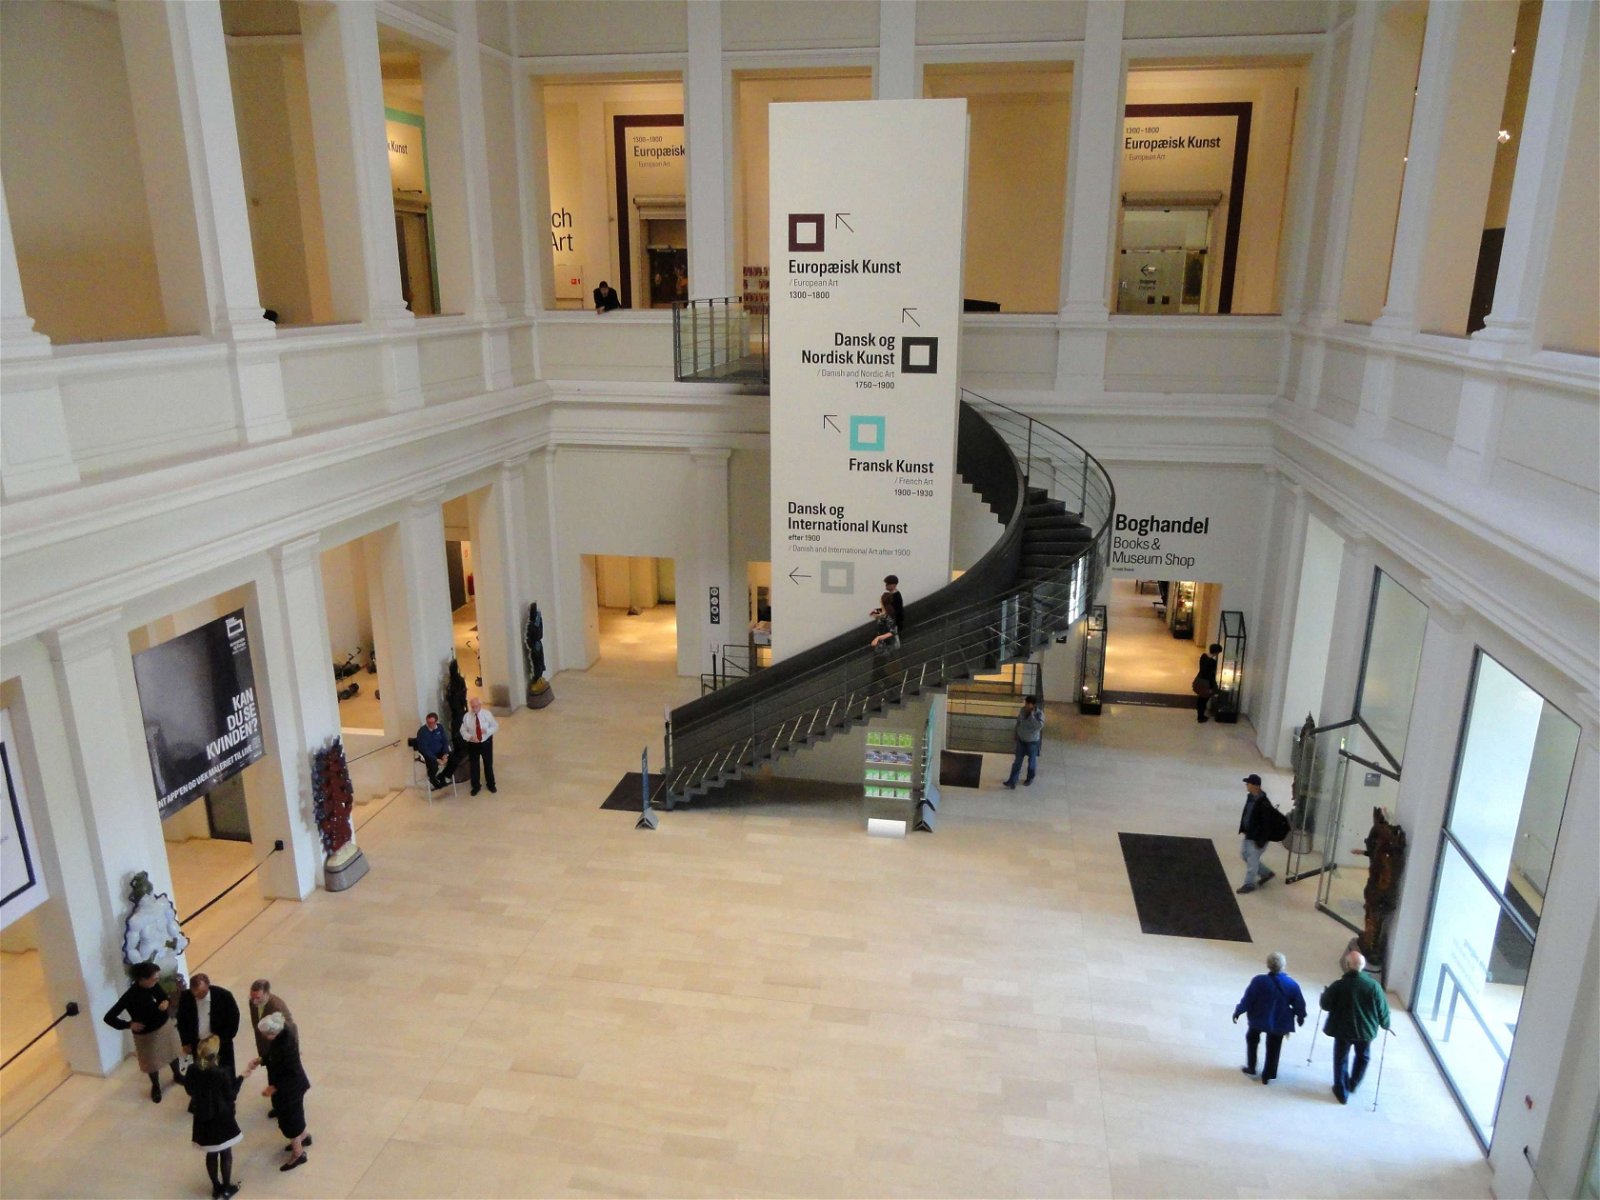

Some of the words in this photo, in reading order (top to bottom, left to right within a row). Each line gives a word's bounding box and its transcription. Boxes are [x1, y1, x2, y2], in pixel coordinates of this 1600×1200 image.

[634, 145, 686, 159] Europæisk
[1125, 136, 1185, 152] Europæisk
[1188, 136, 1221, 148] Kunst
[788, 260, 859, 277] Europæisk
[862, 260, 901, 274] Kunst
[793, 279, 827, 288] European
[834, 332, 876, 347] Dansk
[879, 336, 895, 350] og
[802, 350, 854, 364] Nordisk
[856, 351, 895, 365] Kunst
[821, 369, 845, 377] Danish
[860, 370, 884, 378] Nordic
[849, 458, 893, 472] Fransk
[896, 459, 934, 474] Kunst
[899, 477, 922, 485] French
[788, 502, 826, 516] Dansk
[829, 506, 844, 519] og
[788, 517, 868, 532] International
[872, 520, 908, 534] Kunst
[1115, 514, 1209, 536] Boghandel
[827, 546, 867, 555] International
[1114, 537, 1150, 550] Books
[1151, 538, 1160, 550] &
[1112, 551, 1162, 565] Museum
[1165, 553, 1195, 568] Shop
[232, 688, 254, 711] KAN
[227, 710, 243, 731] DU
[243, 702, 256, 721] SE
[206, 718, 258, 760] KVINDEN?
[188, 780, 197, 790] OG
[208, 756, 235, 776] MALERIET
[234, 751, 243, 762] TIL
